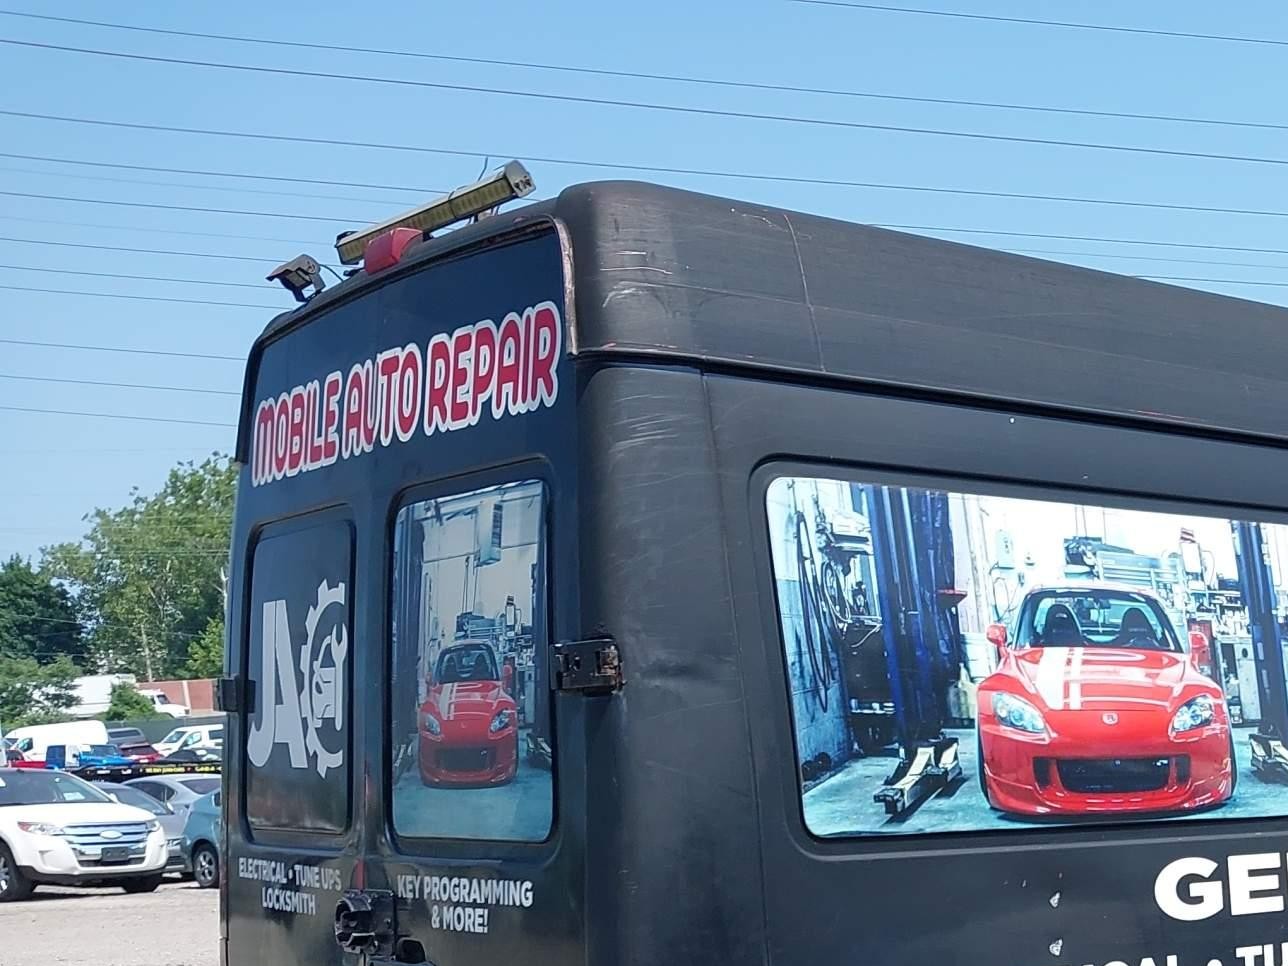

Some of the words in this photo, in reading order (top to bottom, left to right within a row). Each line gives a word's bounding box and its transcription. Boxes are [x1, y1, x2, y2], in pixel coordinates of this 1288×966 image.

[252, 370, 342, 487] MOBILE
[342, 342, 422, 460] AUTO
[424, 301, 560, 436] REPAIR
[238, 857, 287, 885] ELECTRICAL
[294, 864, 320, 889] TUNE
[321, 867, 342, 891] UPS
[397, 874, 423, 899] KEY
[424, 876, 534, 908] PROGRAMMING
[261, 887, 316, 915] LOCKSMITH
[431, 906, 441, 930] &
[442, 907, 489, 934] MORE!
